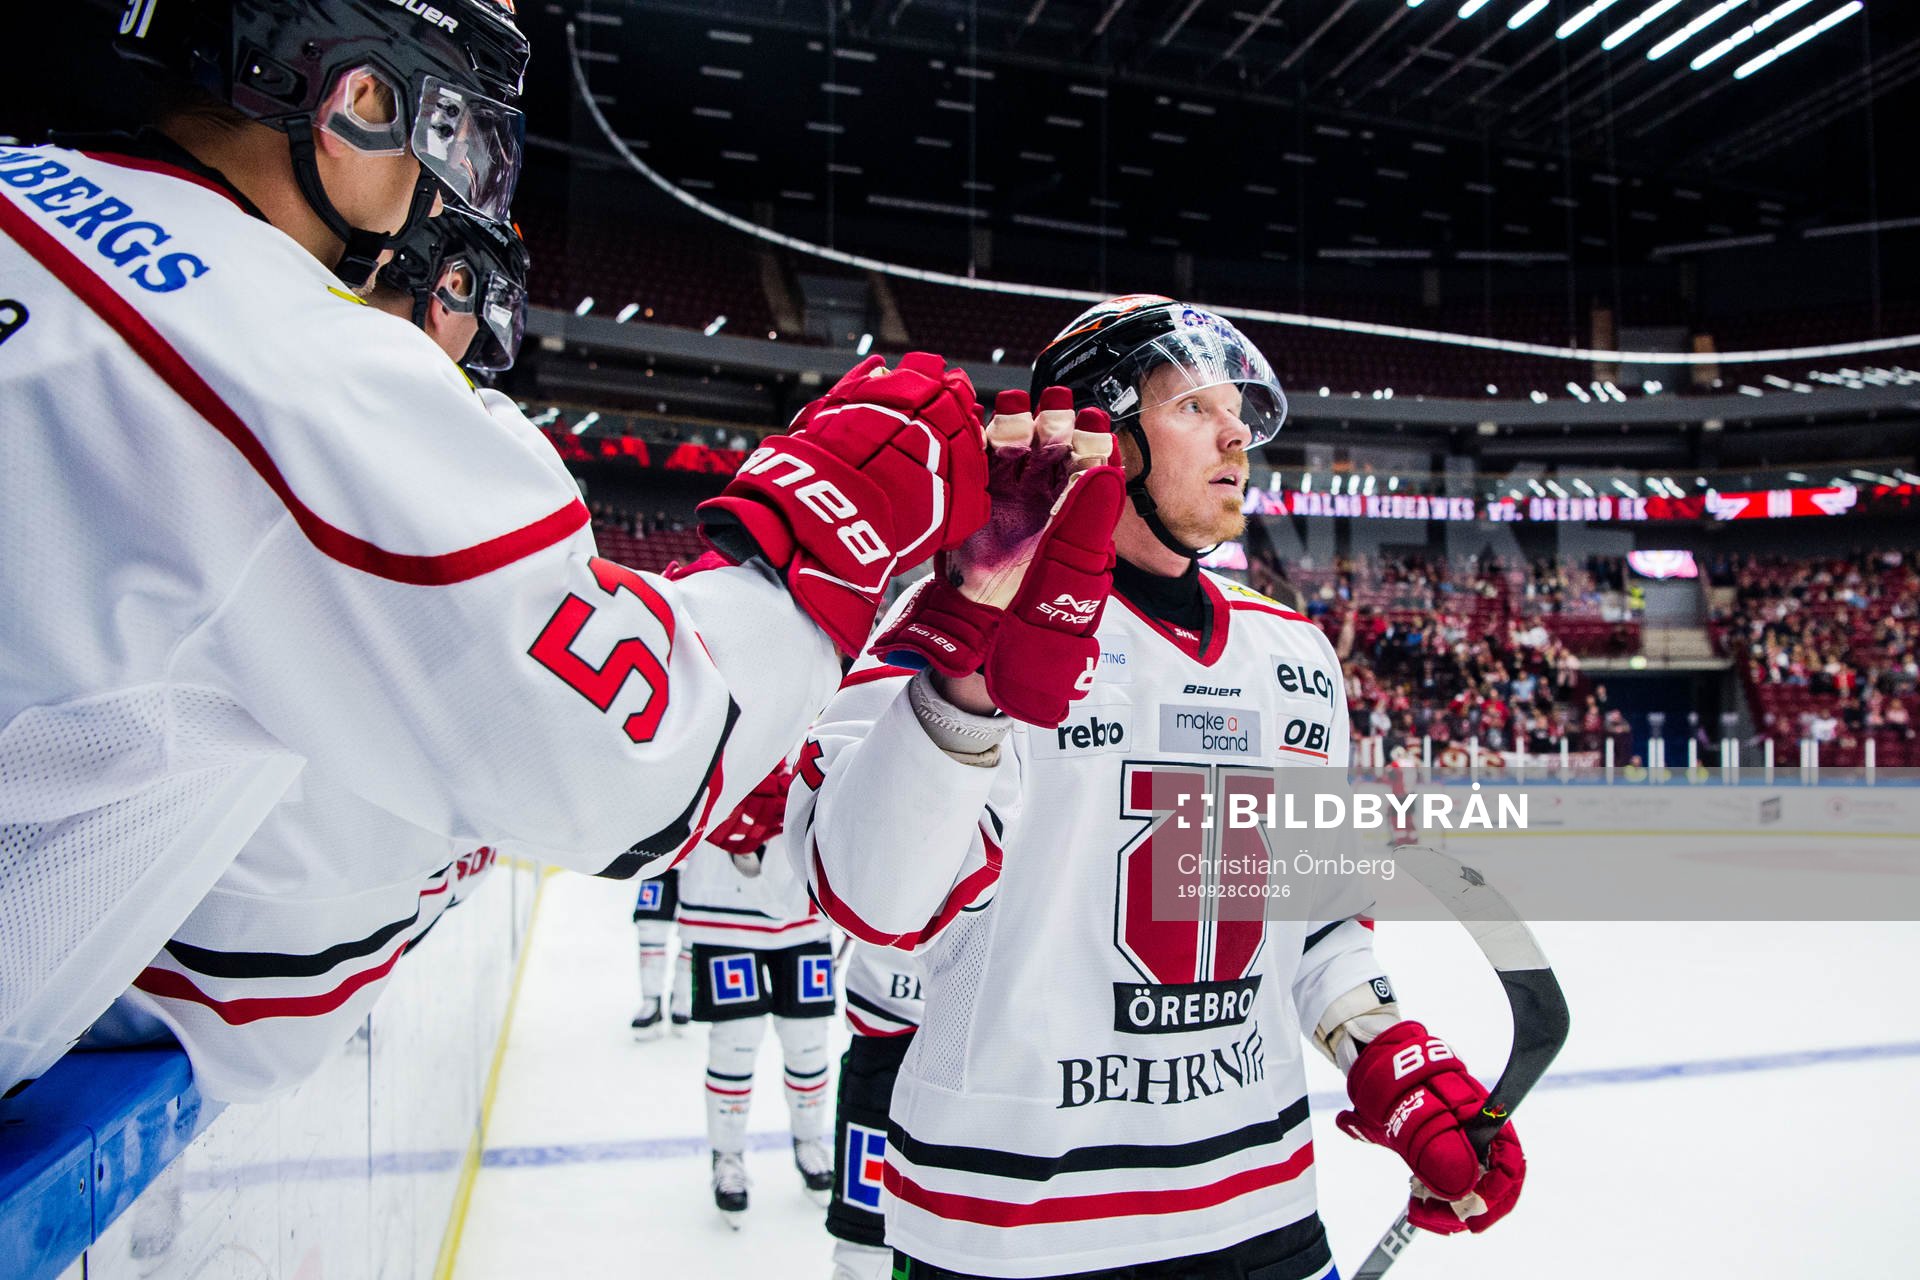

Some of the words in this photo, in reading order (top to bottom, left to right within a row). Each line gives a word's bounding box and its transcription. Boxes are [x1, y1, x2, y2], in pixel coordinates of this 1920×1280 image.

[528, 555, 676, 744] 51
[1101, 652, 1126, 665] TING
[1176, 711, 1225, 731] make
[1227, 717, 1238, 732] a
[1202, 729, 1249, 752] brand
[1128, 988, 1255, 1027] ÖREBRO
